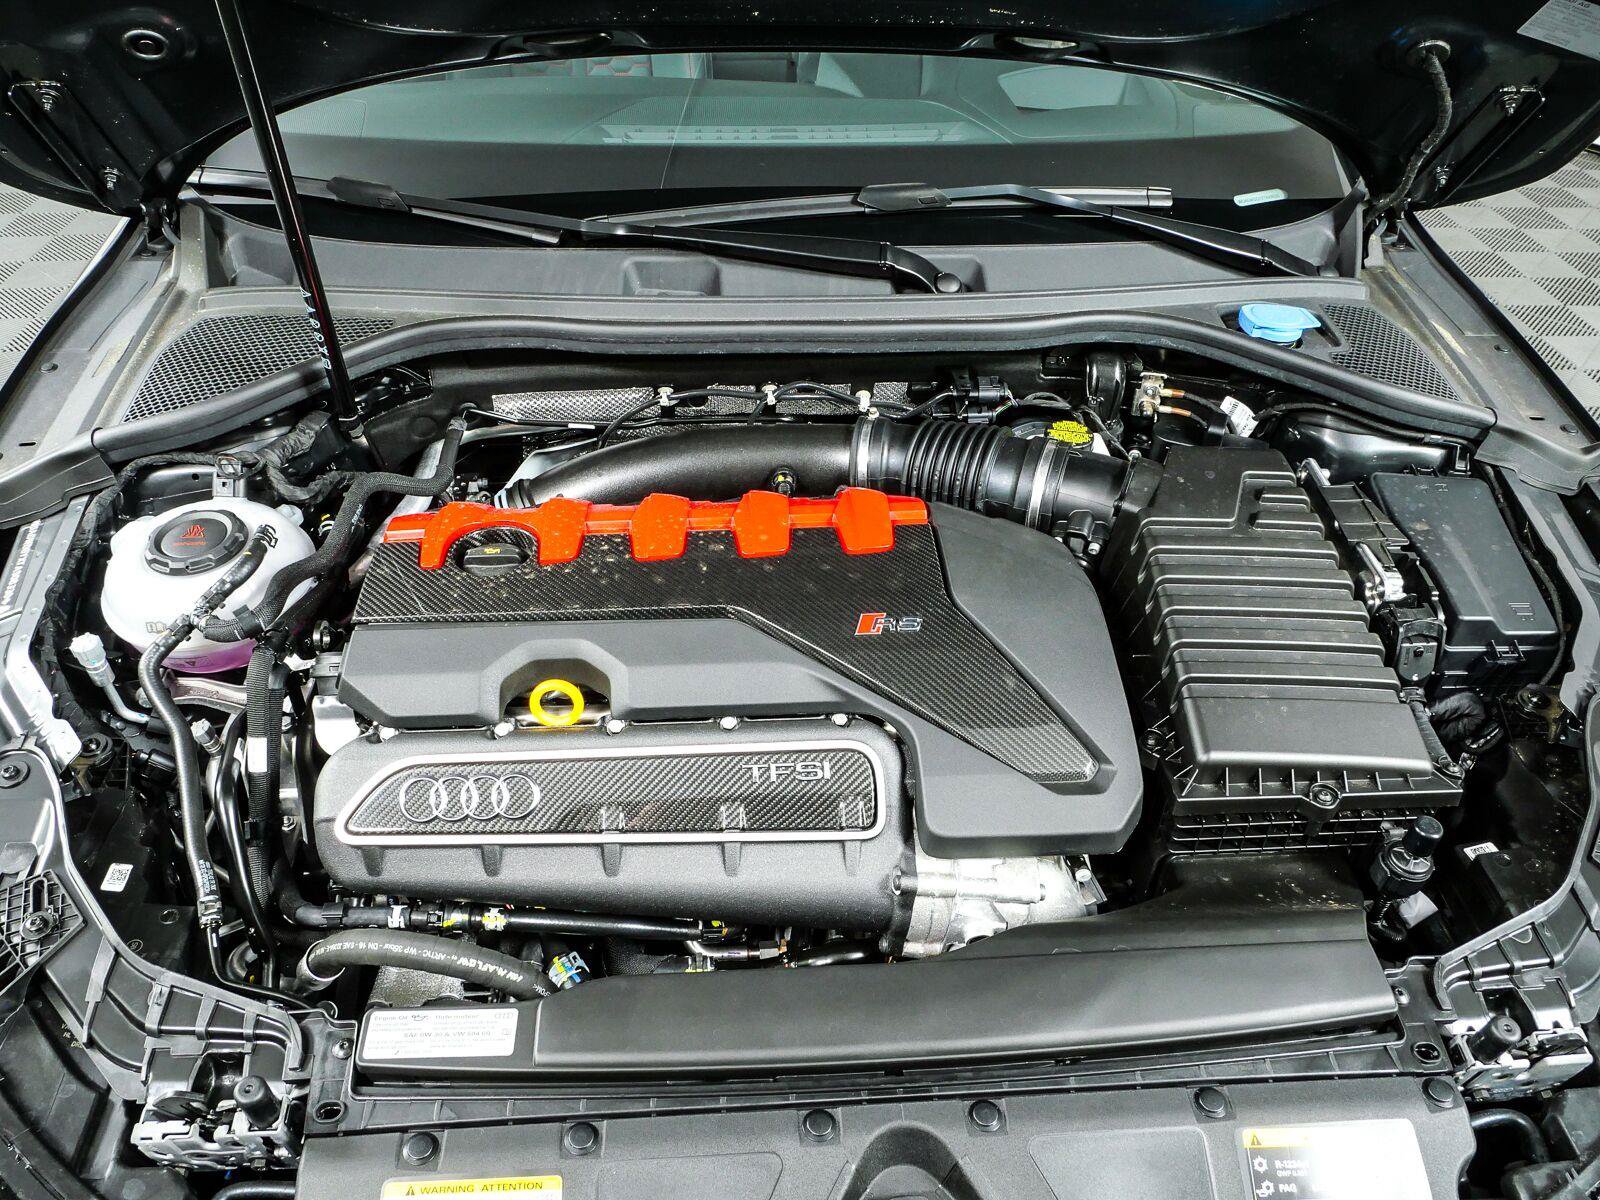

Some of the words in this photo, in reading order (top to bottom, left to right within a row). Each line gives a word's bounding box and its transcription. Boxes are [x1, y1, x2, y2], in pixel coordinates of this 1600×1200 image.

[861, 614, 923, 634] RS
[742, 761, 830, 782] TFSI
[420, 1184, 475, 1195] WARNING
[481, 1181, 543, 1192] ATTENTION
[1279, 1184, 1297, 1193] PAG
